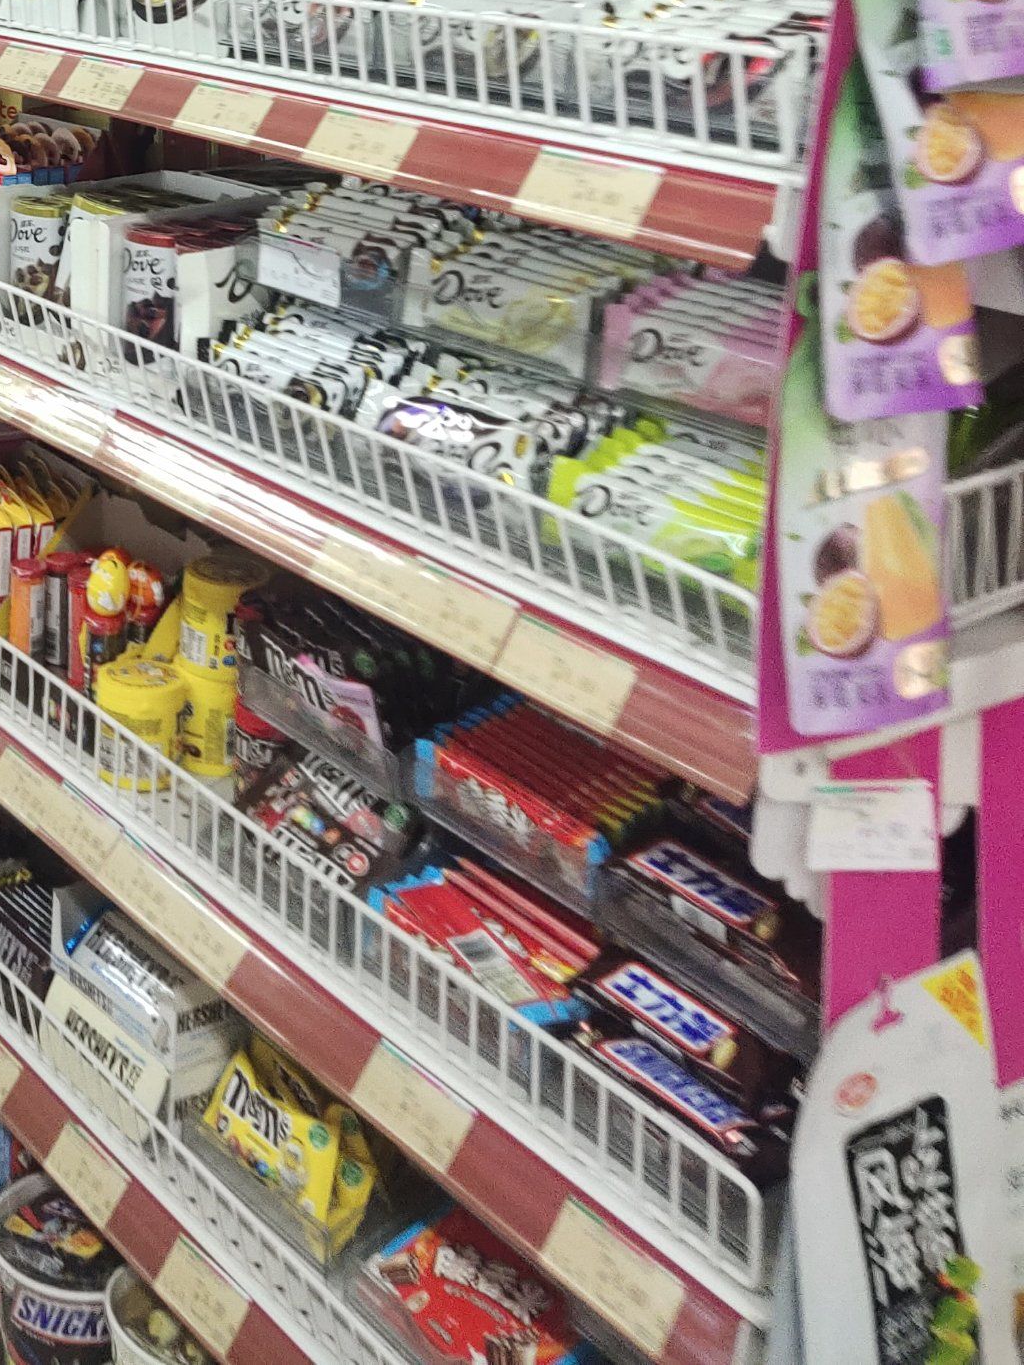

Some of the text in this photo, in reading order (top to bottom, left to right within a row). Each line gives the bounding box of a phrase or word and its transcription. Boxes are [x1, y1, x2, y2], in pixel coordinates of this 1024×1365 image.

[10, 218, 48, 243] Dove
[123, 247, 164, 274] Dove
[613, 968, 723, 1049] 士力架
